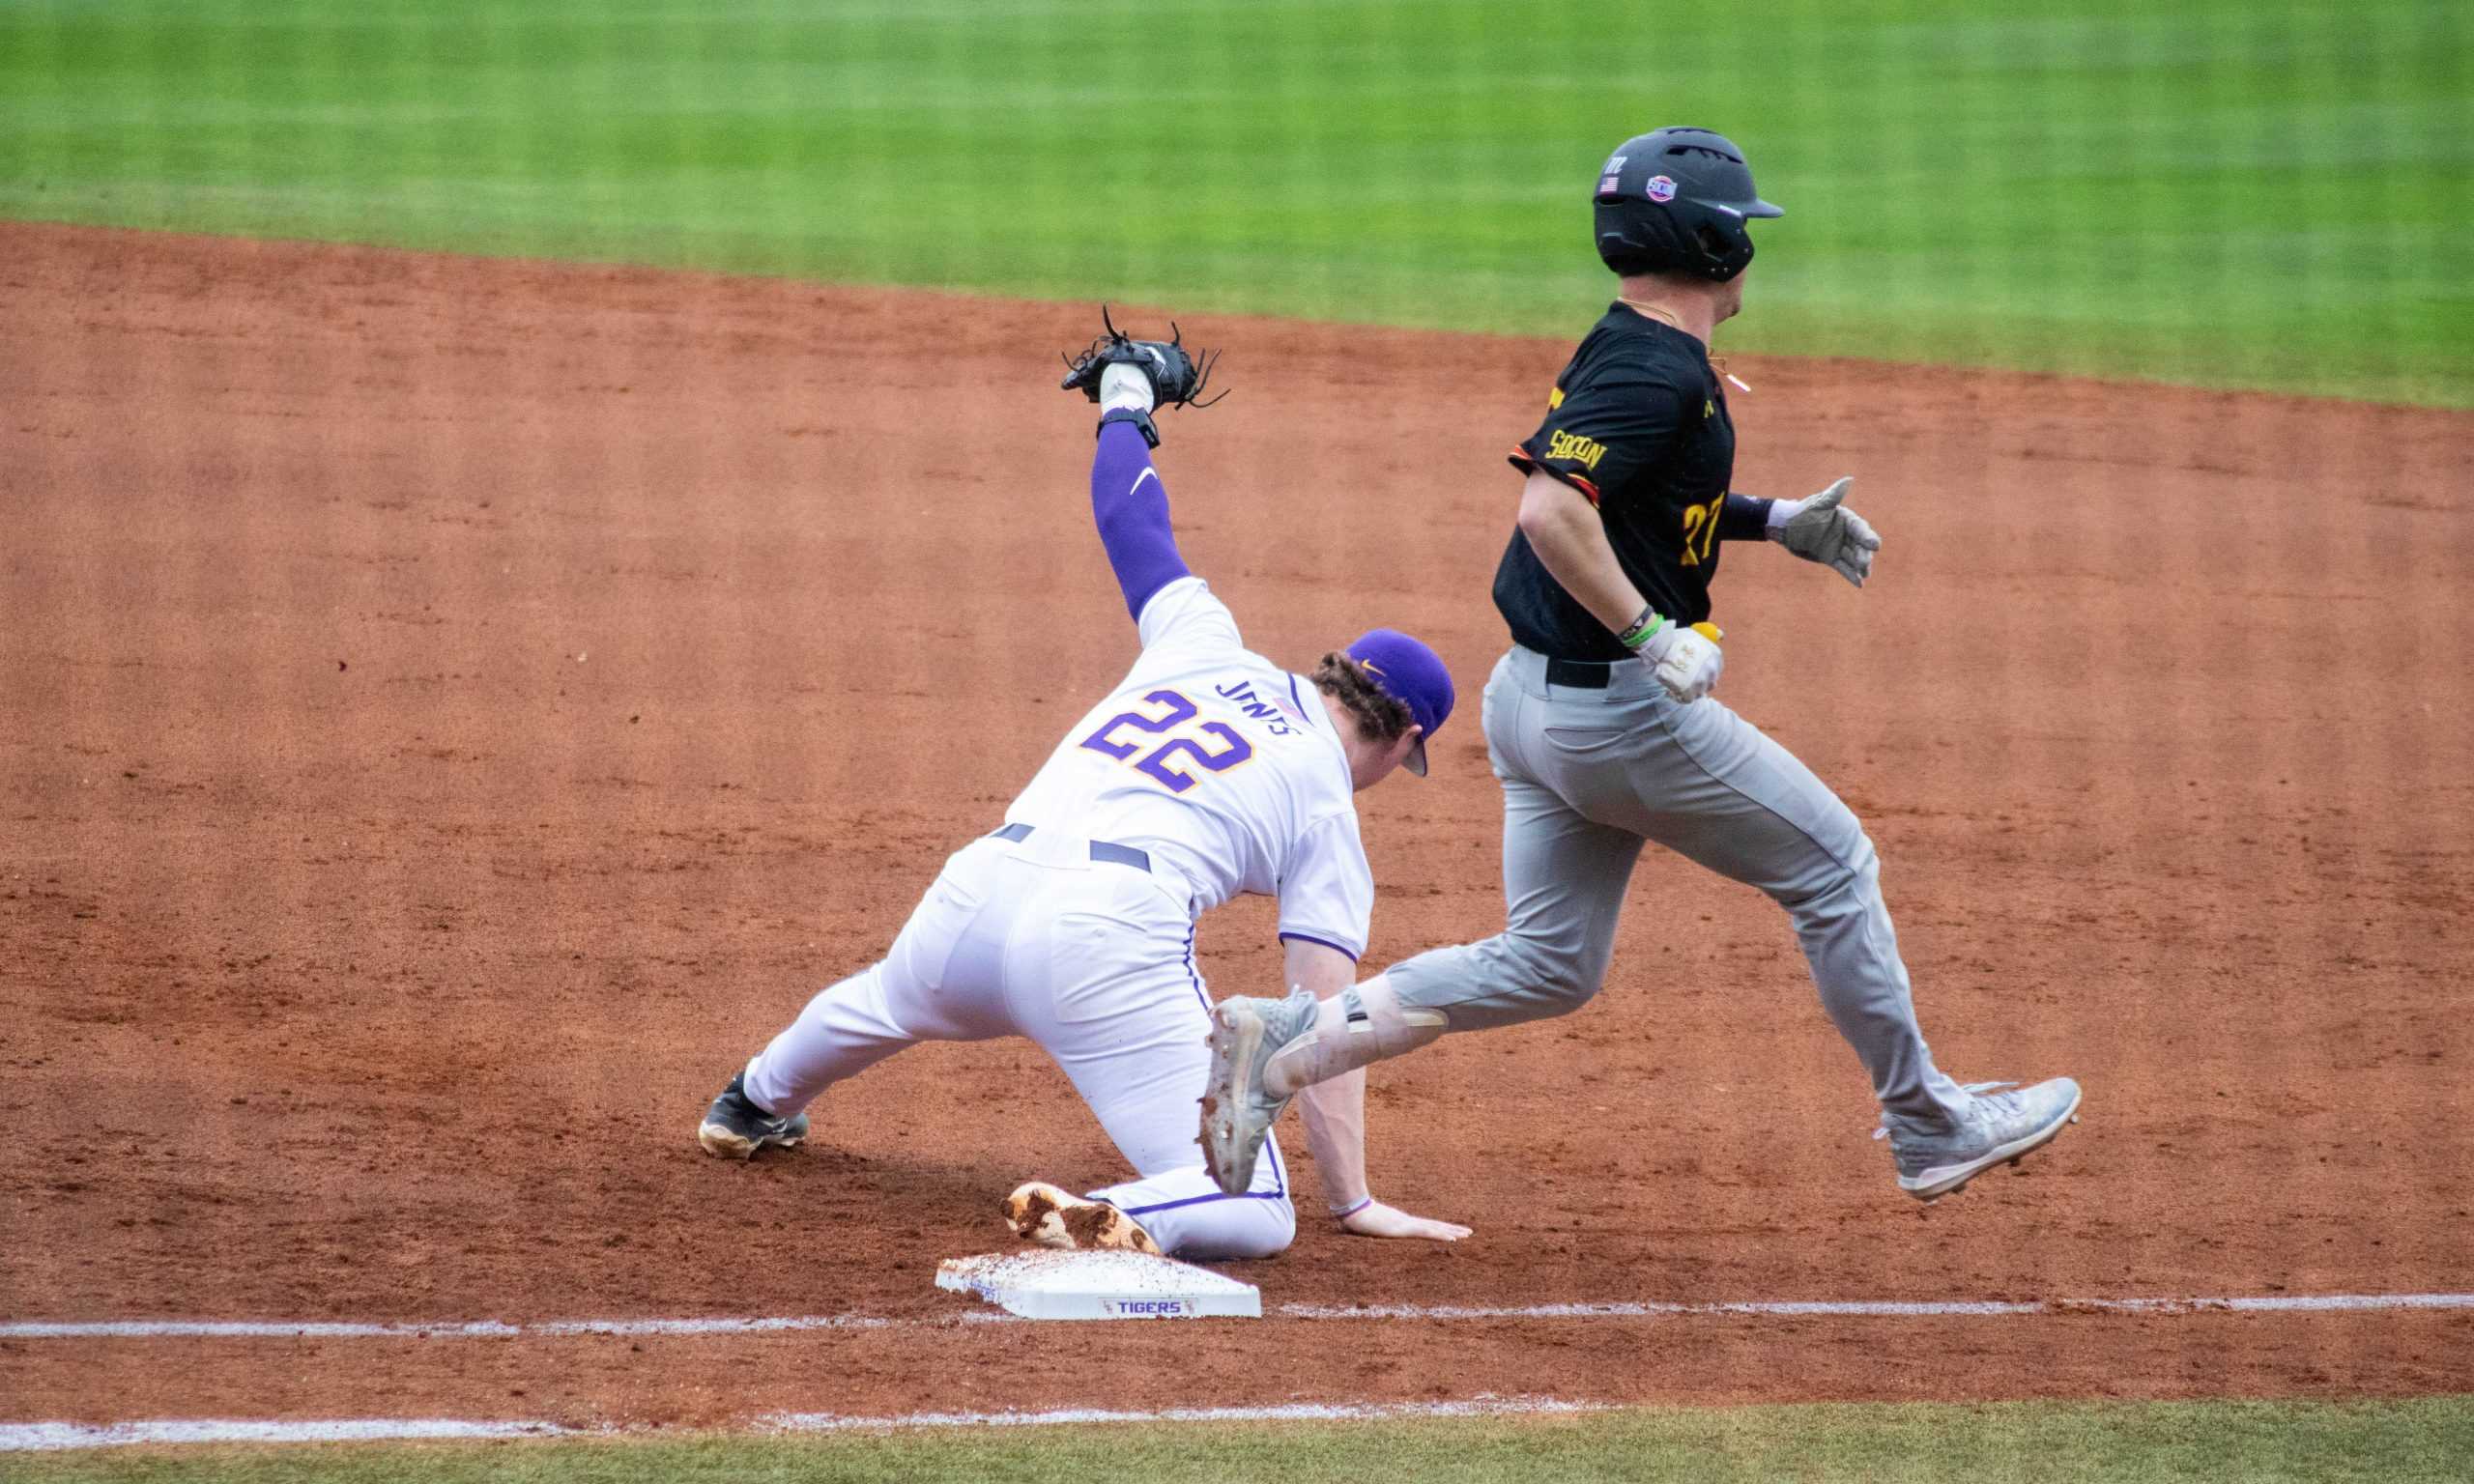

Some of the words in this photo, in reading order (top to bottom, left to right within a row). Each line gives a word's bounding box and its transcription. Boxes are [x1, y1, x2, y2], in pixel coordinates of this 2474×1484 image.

[1545, 429, 1608, 471] SOCON
[1078, 688, 1253, 794] 22
[1117, 1301, 1181, 1314] TIGERS
